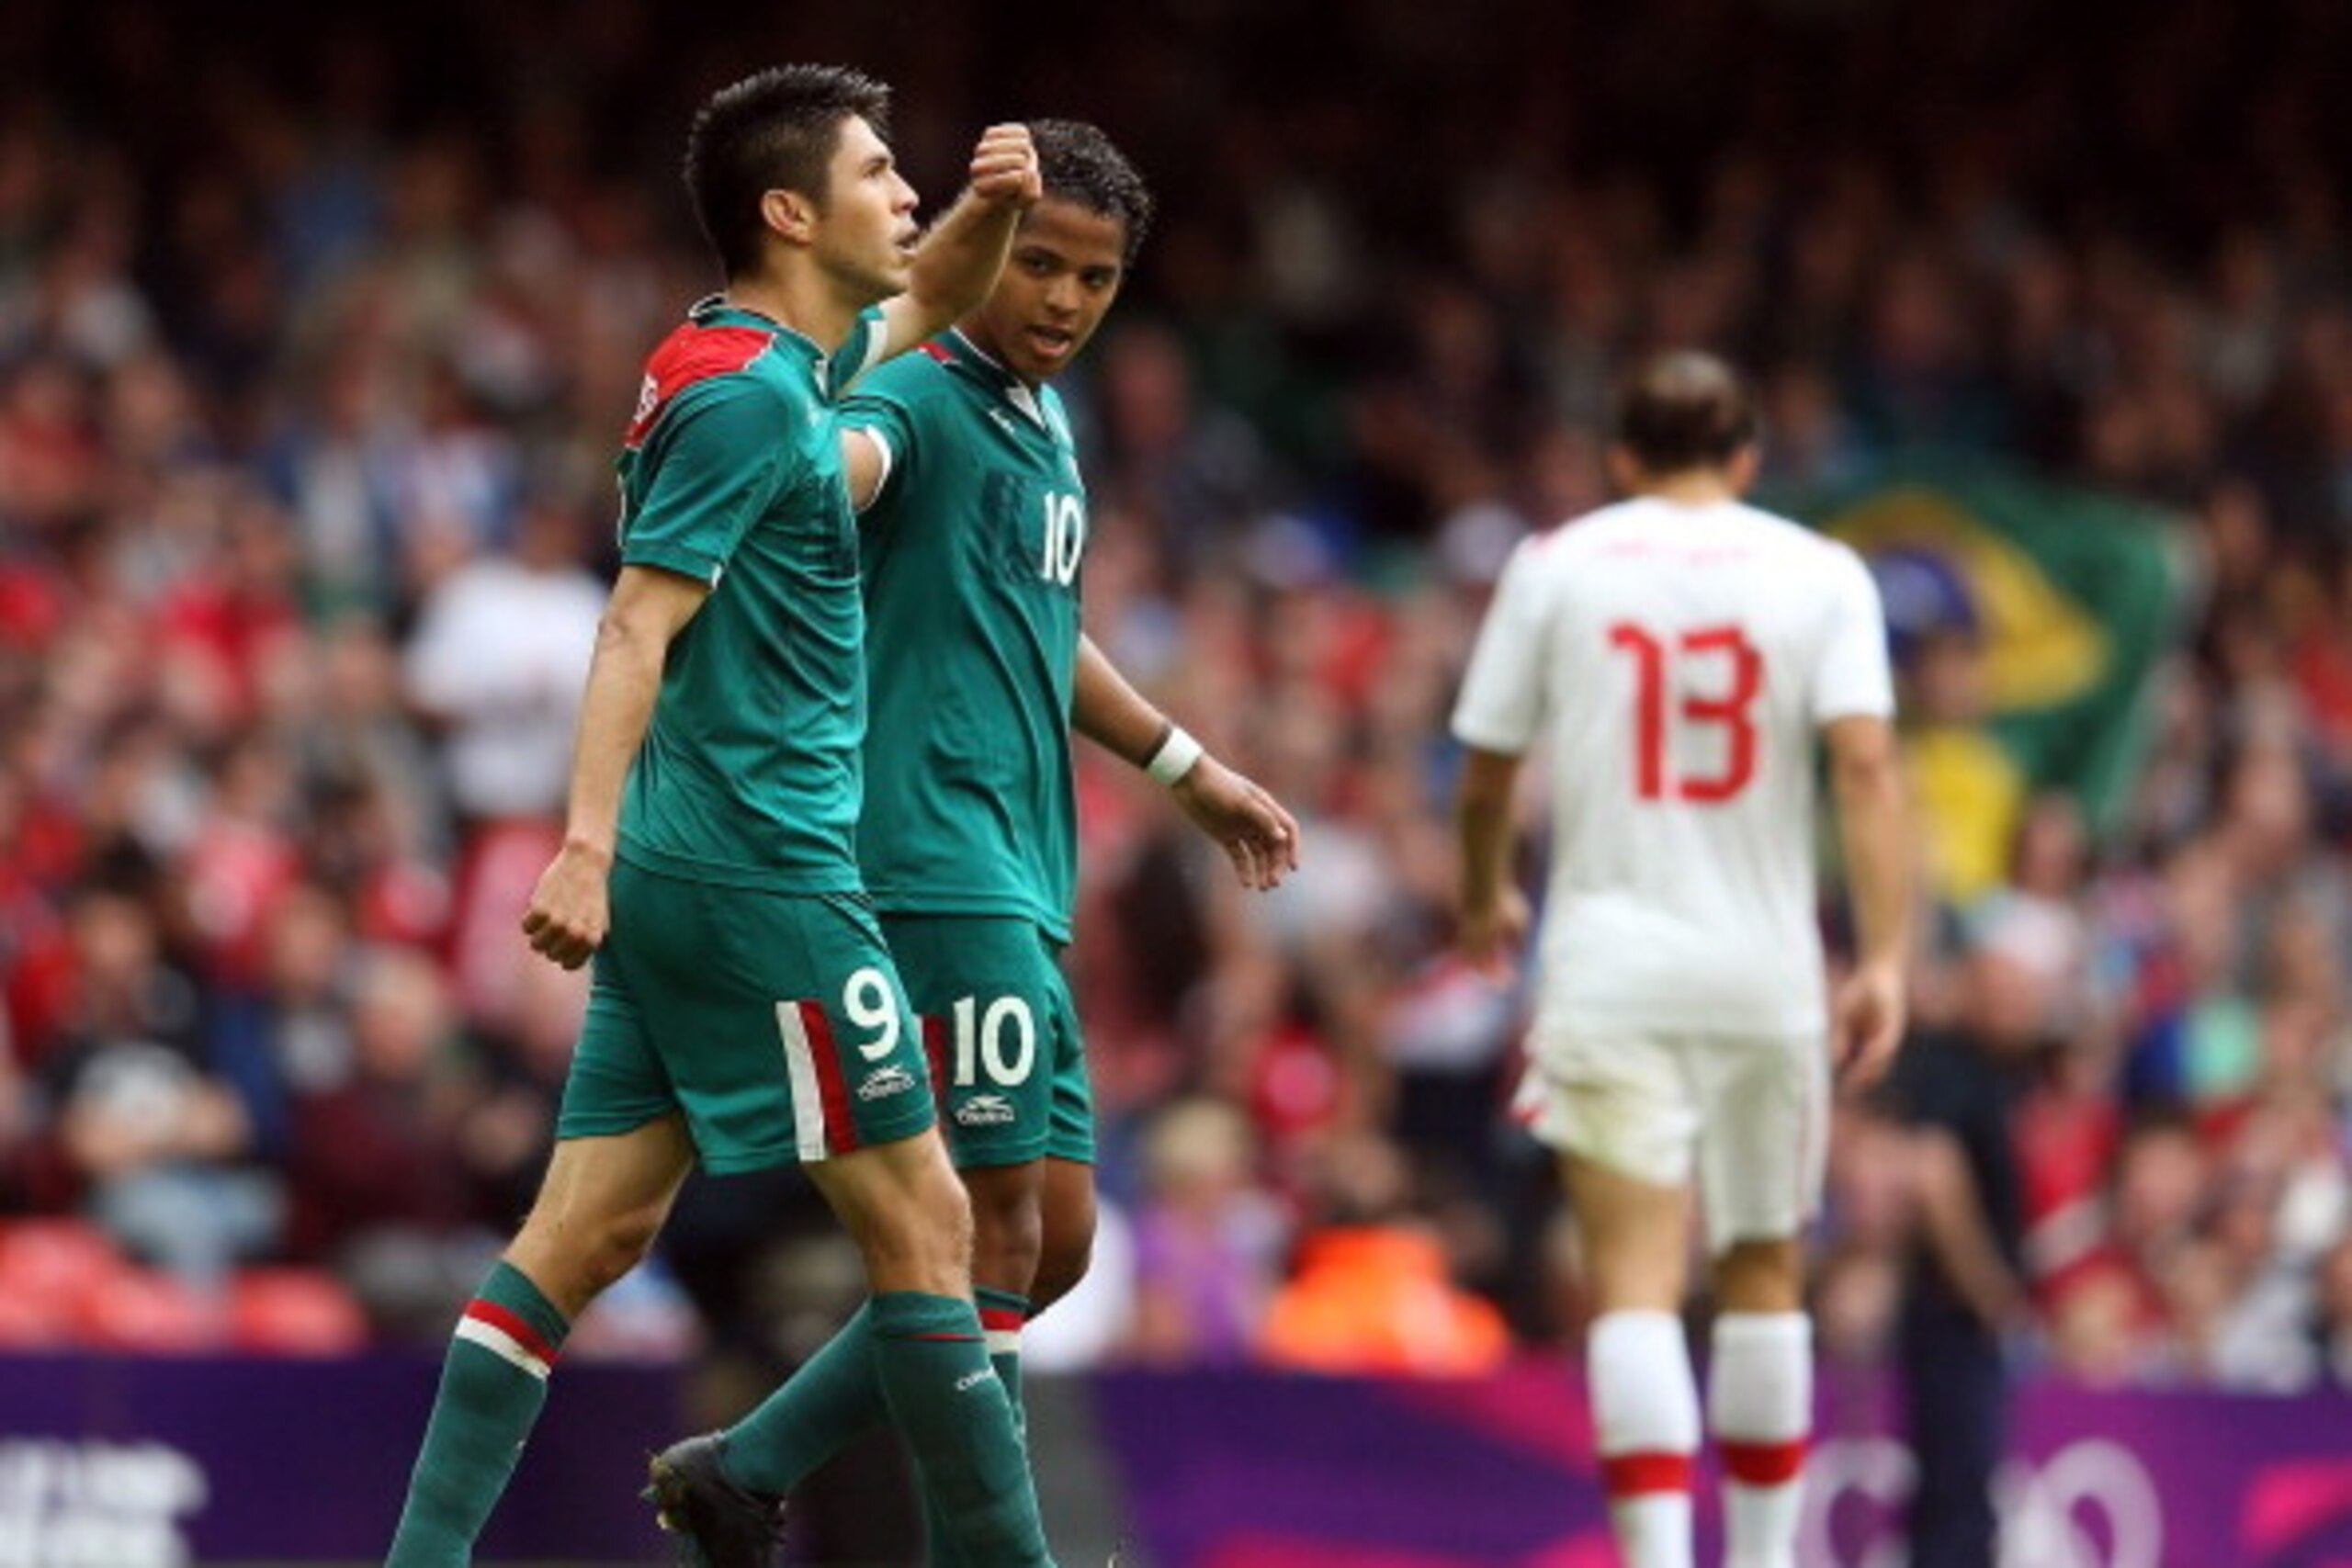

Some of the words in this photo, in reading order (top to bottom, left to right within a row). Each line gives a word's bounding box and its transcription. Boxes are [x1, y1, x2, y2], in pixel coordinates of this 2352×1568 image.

[1041, 491, 1084, 587] 10
[1607, 622, 1763, 806] 13
[842, 967, 900, 1062] 9
[953, 995, 1035, 1087] 10
